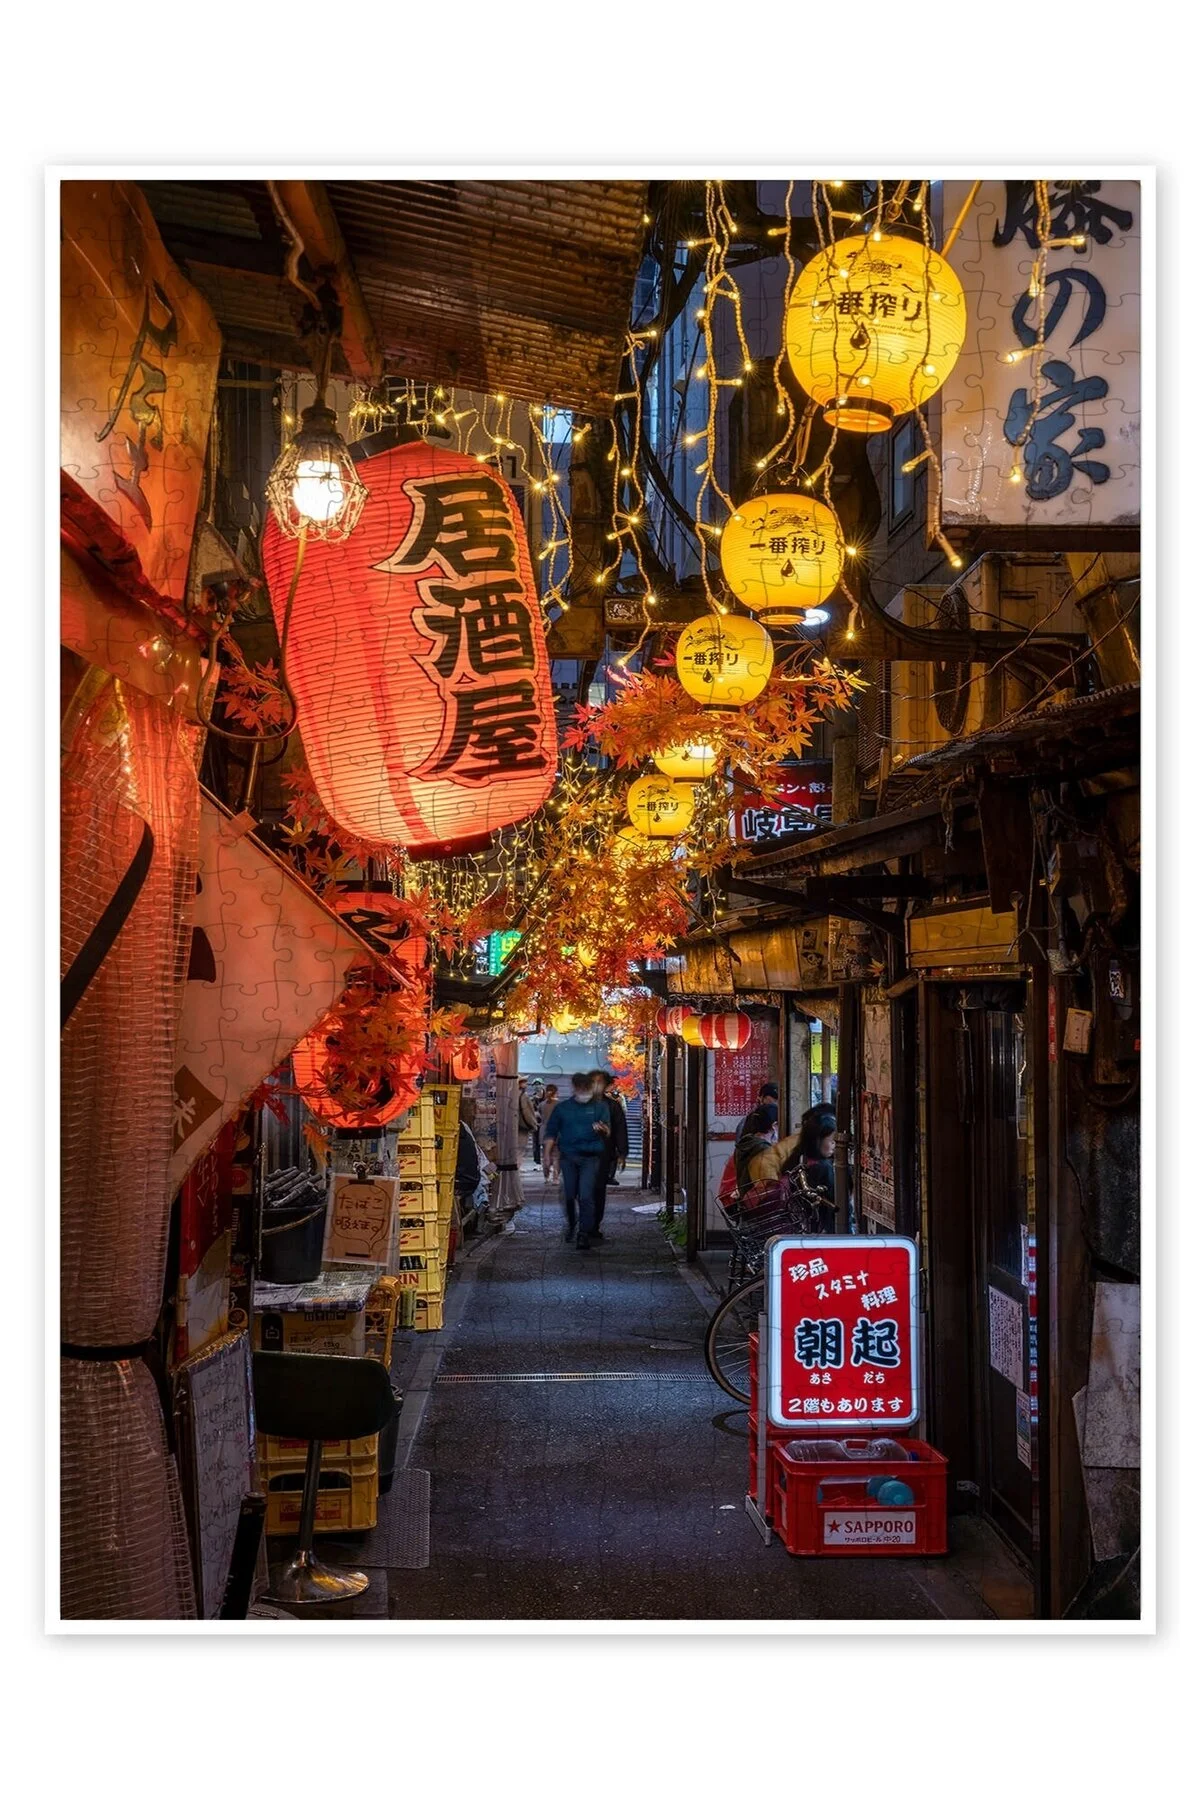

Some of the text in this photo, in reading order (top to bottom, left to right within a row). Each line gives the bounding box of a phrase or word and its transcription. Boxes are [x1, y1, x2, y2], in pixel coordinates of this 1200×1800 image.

[749, 536, 826, 555] 一番搾り
[376, 474, 548, 785] 居酒屋
[683, 652, 739, 666] 一番搾り
[637, 801, 679, 812] 一番搾り
[338, 1195, 384, 1210] たばこ
[788, 1257, 829, 1283] 珍品
[815, 1270, 870, 1300] スタミナ
[861, 1285, 898, 1311] 料理
[810, 1371, 885, 1385] あさ だち
[788, 1397, 904, 1414] 2階もあります
[844, 1520, 914, 1533] SAPPORO
